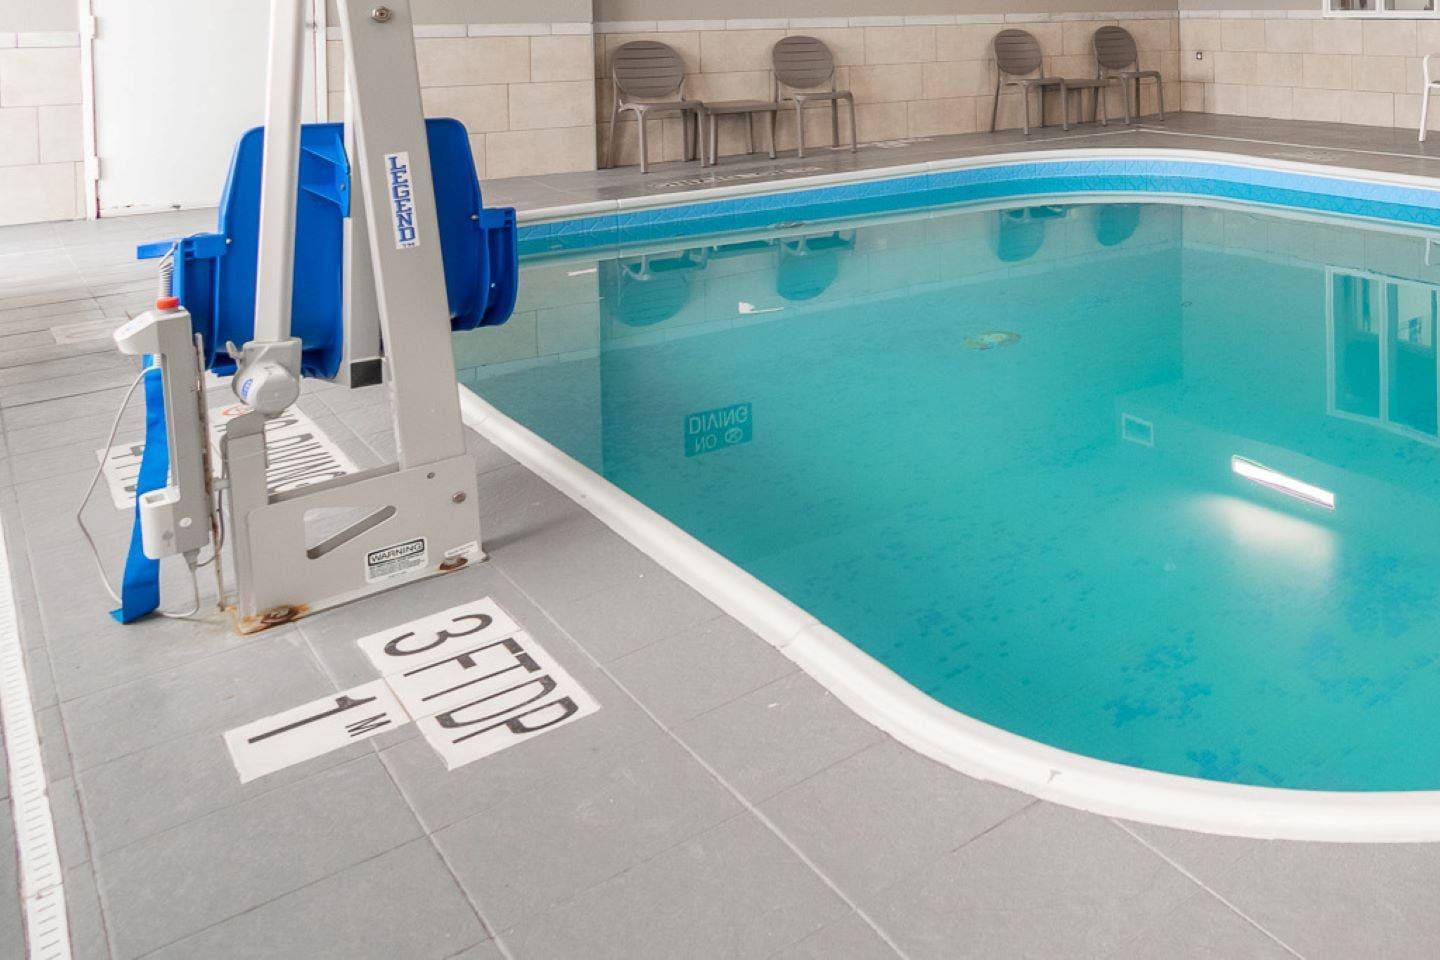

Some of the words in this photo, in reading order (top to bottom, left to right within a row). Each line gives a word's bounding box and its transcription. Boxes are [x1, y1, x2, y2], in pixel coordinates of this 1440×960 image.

[388, 156, 416, 242] LEGEND
[371, 544, 423, 563] WARNING
[383, 613, 493, 657] 3
[248, 695, 377, 744] 1
[345, 712, 392, 737] M
